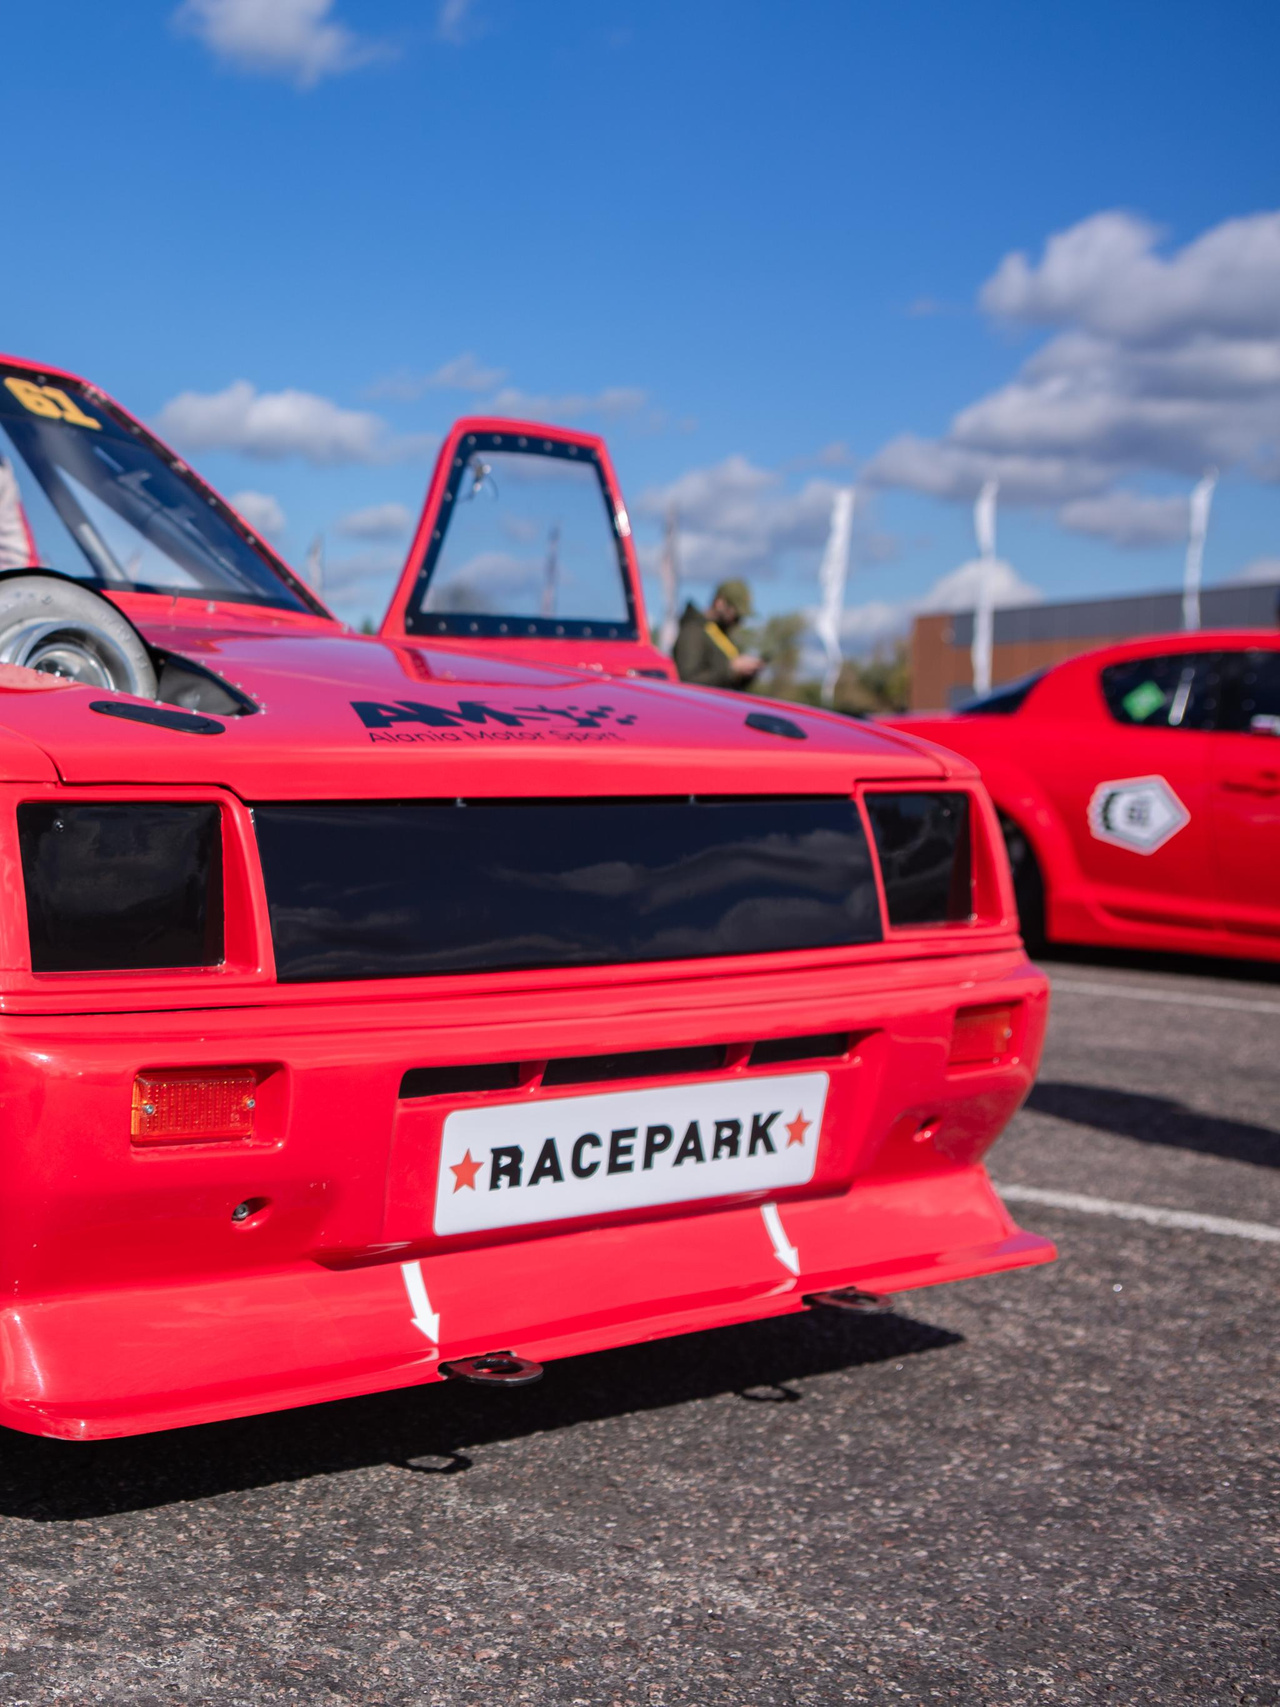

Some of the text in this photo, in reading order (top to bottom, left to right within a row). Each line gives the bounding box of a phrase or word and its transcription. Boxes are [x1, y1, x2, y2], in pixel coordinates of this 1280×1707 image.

[4, 377, 102, 430] 61
[369, 730, 627, 743] Alania Motor Sport
[488, 1110, 783, 1192] RACEPARK
